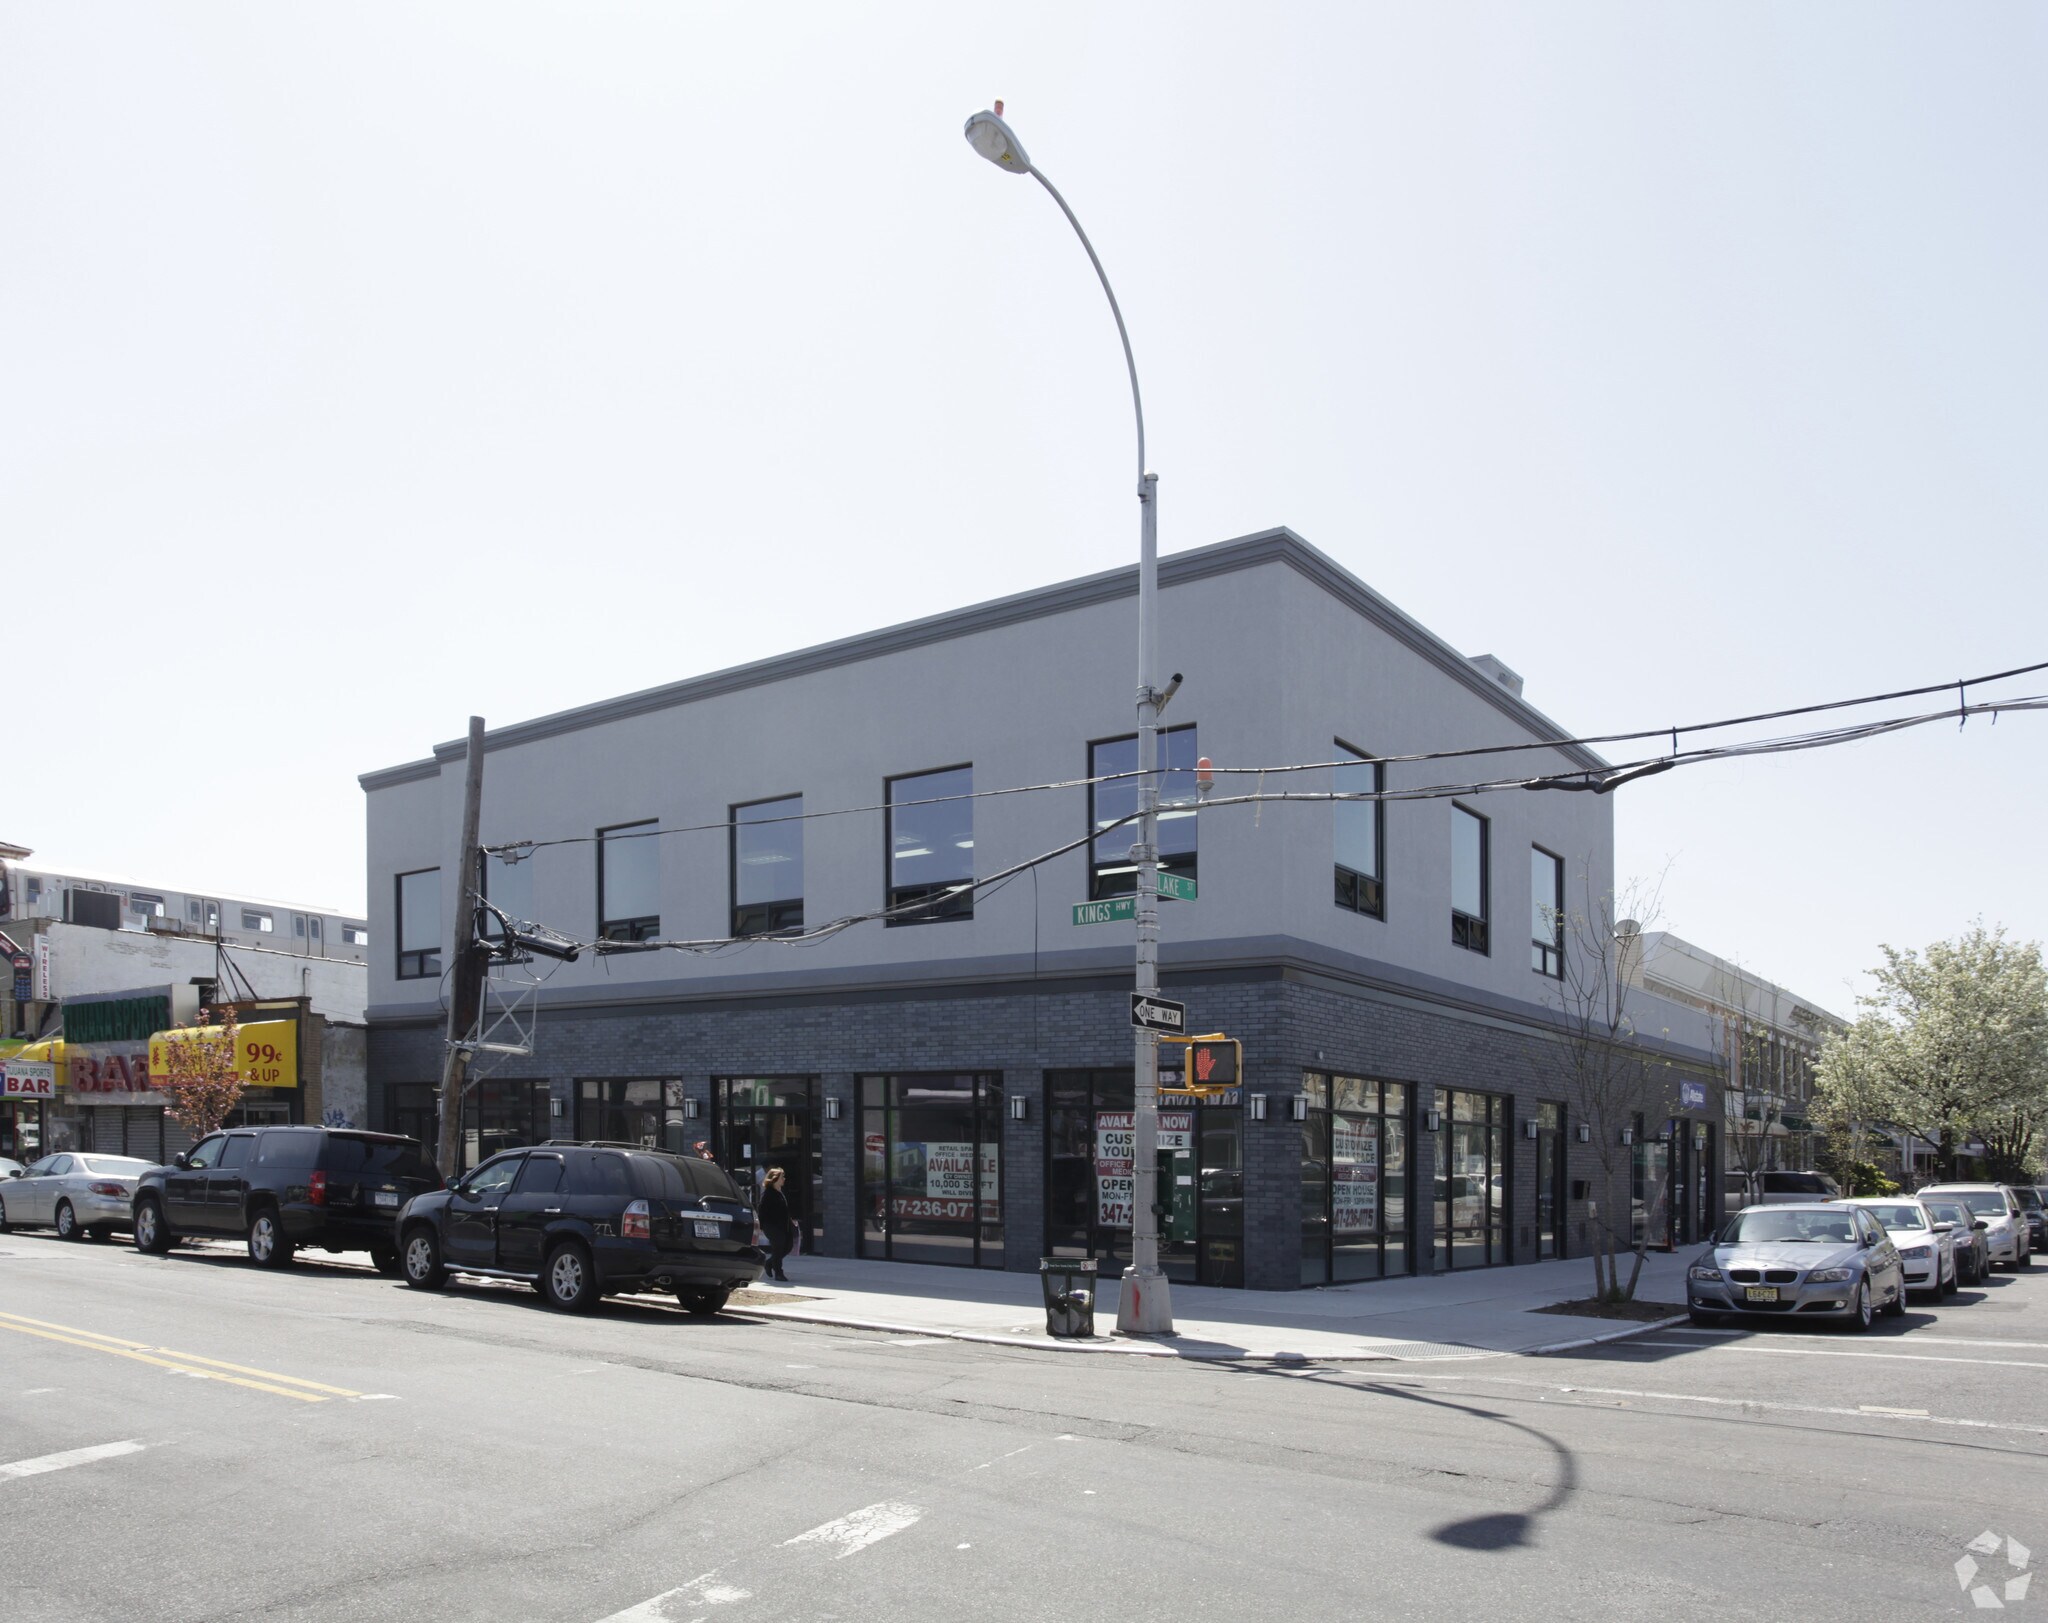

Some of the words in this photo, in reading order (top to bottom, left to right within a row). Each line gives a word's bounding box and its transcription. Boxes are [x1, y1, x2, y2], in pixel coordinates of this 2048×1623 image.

[1157, 875, 1180, 896] LAKE
[1187, 882, 1194, 891] ST
[1077, 903, 1111, 924] KINGS
[1115, 902, 1131, 911] HWY
[41, 945, 49, 999] WIRELESS
[114, 995, 170, 1041] SPORTS
[1139, 1005, 1155, 1020] ONE
[1161, 1009, 1178, 1023] WAY
[29, 1067, 51, 1078] SPORTS
[71, 1054, 149, 1092] BAR
[250, 1067, 260, 1081] &
[262, 1069, 280, 1082] UP
[7, 1077, 50, 1094] BAR
[1100, 1115, 1158, 1128] AVAILA
[1162, 1116, 1190, 1129] NOW
[1105, 1133, 1183, 1146] CUSIZE
[1102, 1146, 1134, 1158] YOU
[928, 1158, 997, 1173] AVAILALE
[1100, 1160, 1126, 1168] OFFICE
[929, 1179, 960, 1190] 10,000
[879, 1199, 975, 1218] 47-236-077
